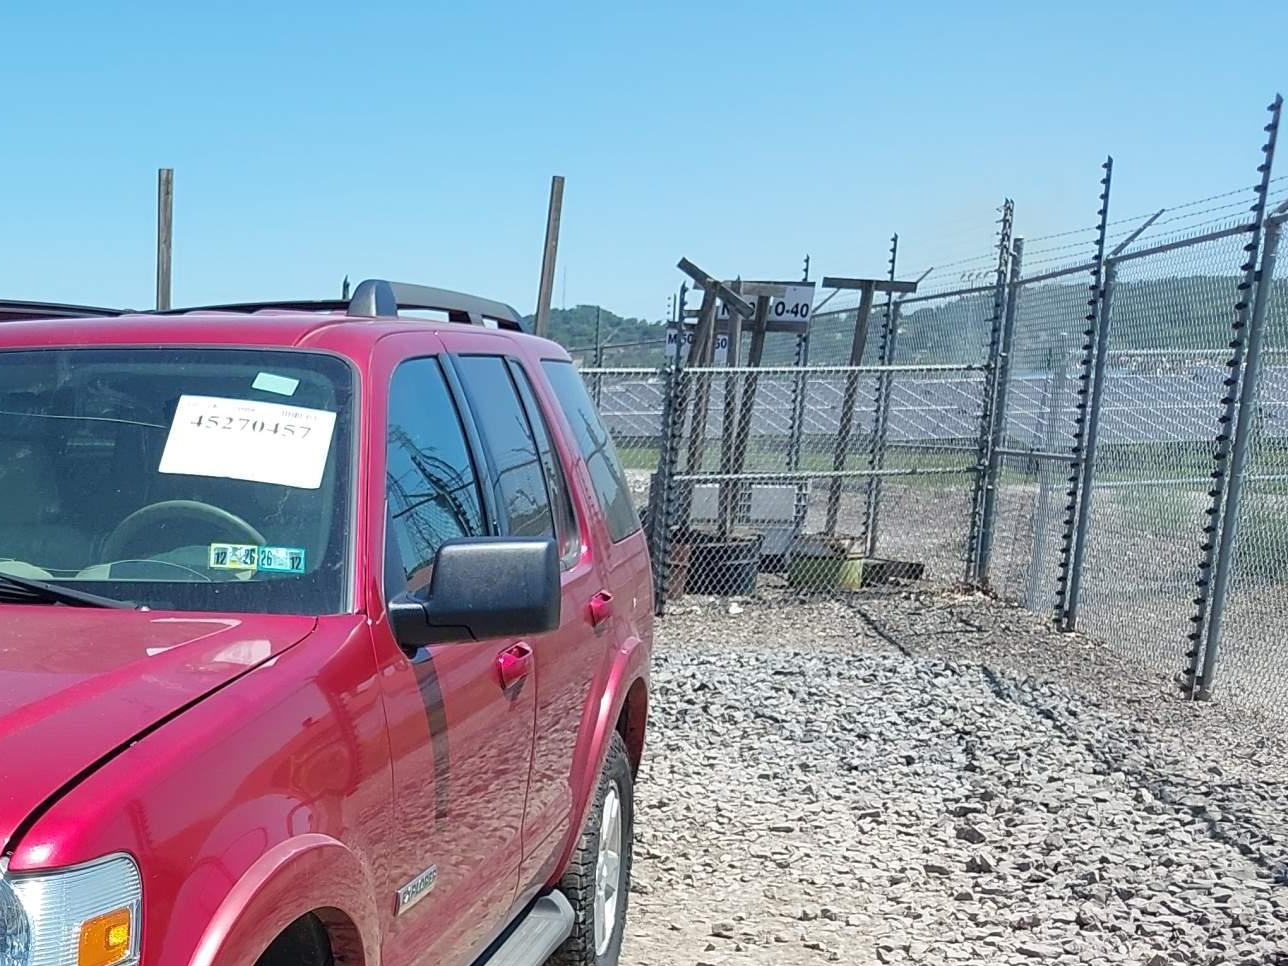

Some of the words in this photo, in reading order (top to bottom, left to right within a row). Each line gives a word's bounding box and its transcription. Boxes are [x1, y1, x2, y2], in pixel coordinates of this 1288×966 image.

[774, 301, 809, 318] O-40
[190, 415, 312, 439] 45270457
[214, 550, 227, 565] 12
[261, 550, 272, 566] 26
[290, 556, 302, 570] 12
